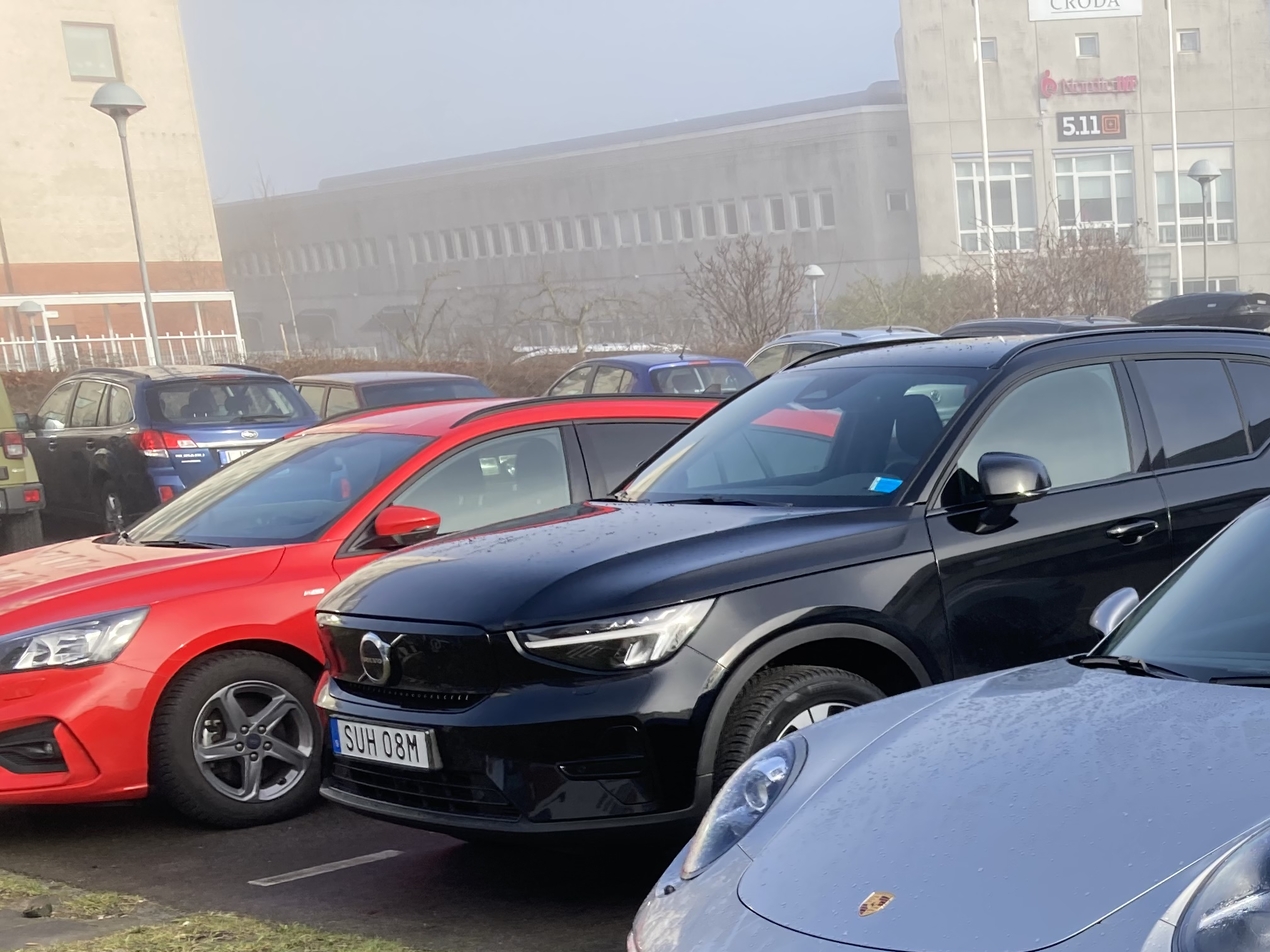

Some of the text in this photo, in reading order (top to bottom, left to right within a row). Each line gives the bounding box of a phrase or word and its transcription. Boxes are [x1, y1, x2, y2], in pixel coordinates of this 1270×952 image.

[1062, 115, 1100, 136] 5.11
[344, 725, 378, 757] SUH
[382, 731, 420, 763] 08M
